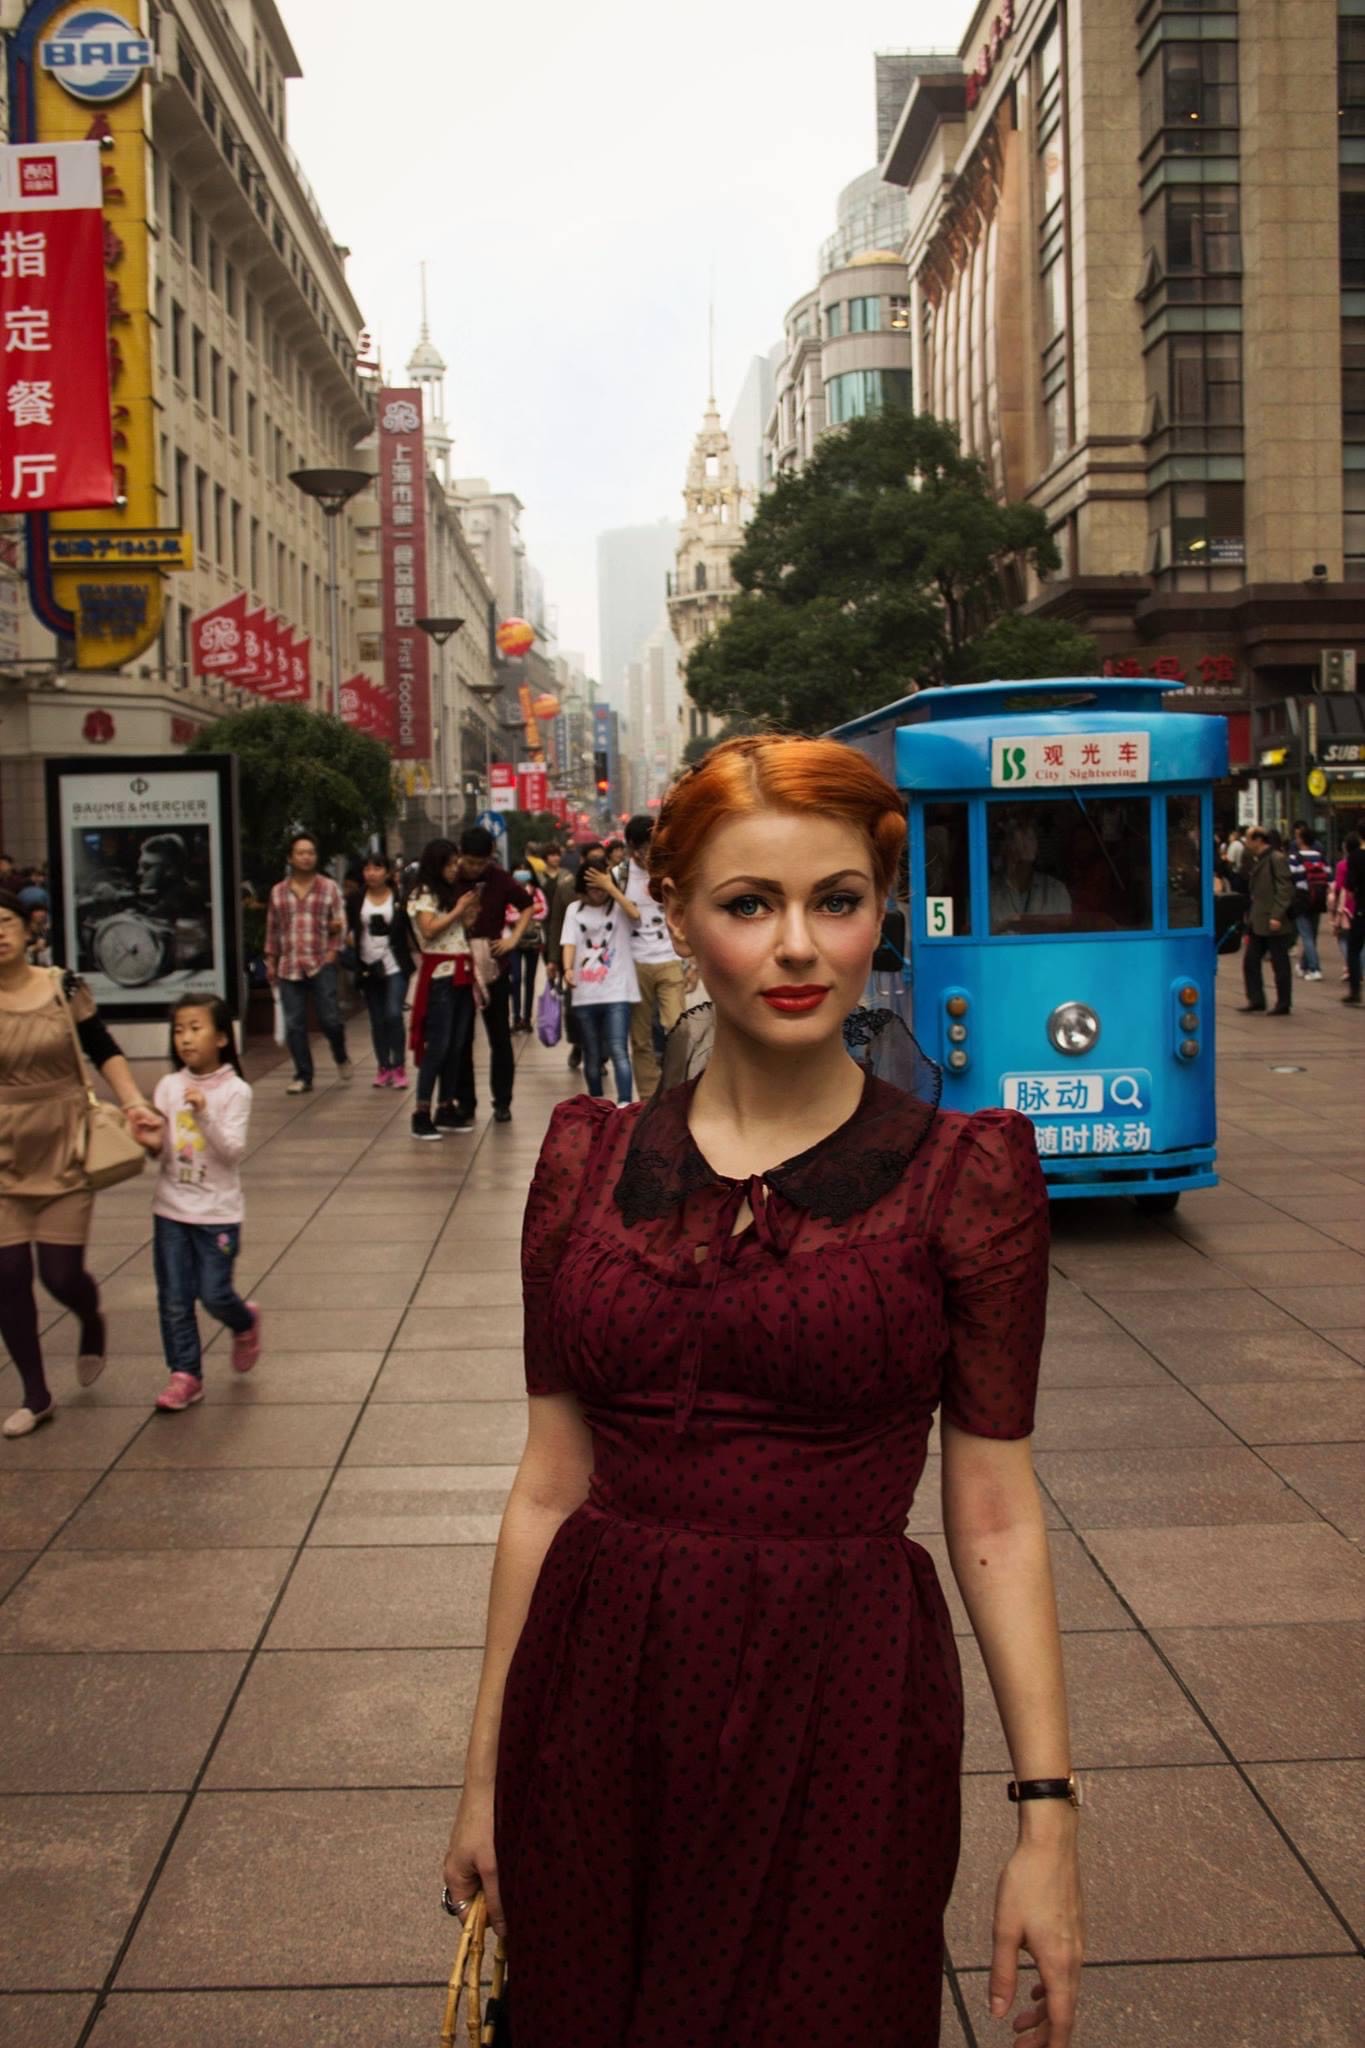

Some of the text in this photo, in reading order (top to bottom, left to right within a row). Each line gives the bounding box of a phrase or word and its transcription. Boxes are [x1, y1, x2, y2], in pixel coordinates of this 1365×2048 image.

[44, 42, 149, 66] BAC
[0, 231, 57, 499] 指定餐厅
[1043, 742, 1138, 767] 观光车
[1034, 766, 1137, 782] City Sightseeing
[933, 901, 946, 932] 5
[1016, 1078, 1089, 1111] 脉动
[1034, 1121, 1152, 1156] 随时脉动
